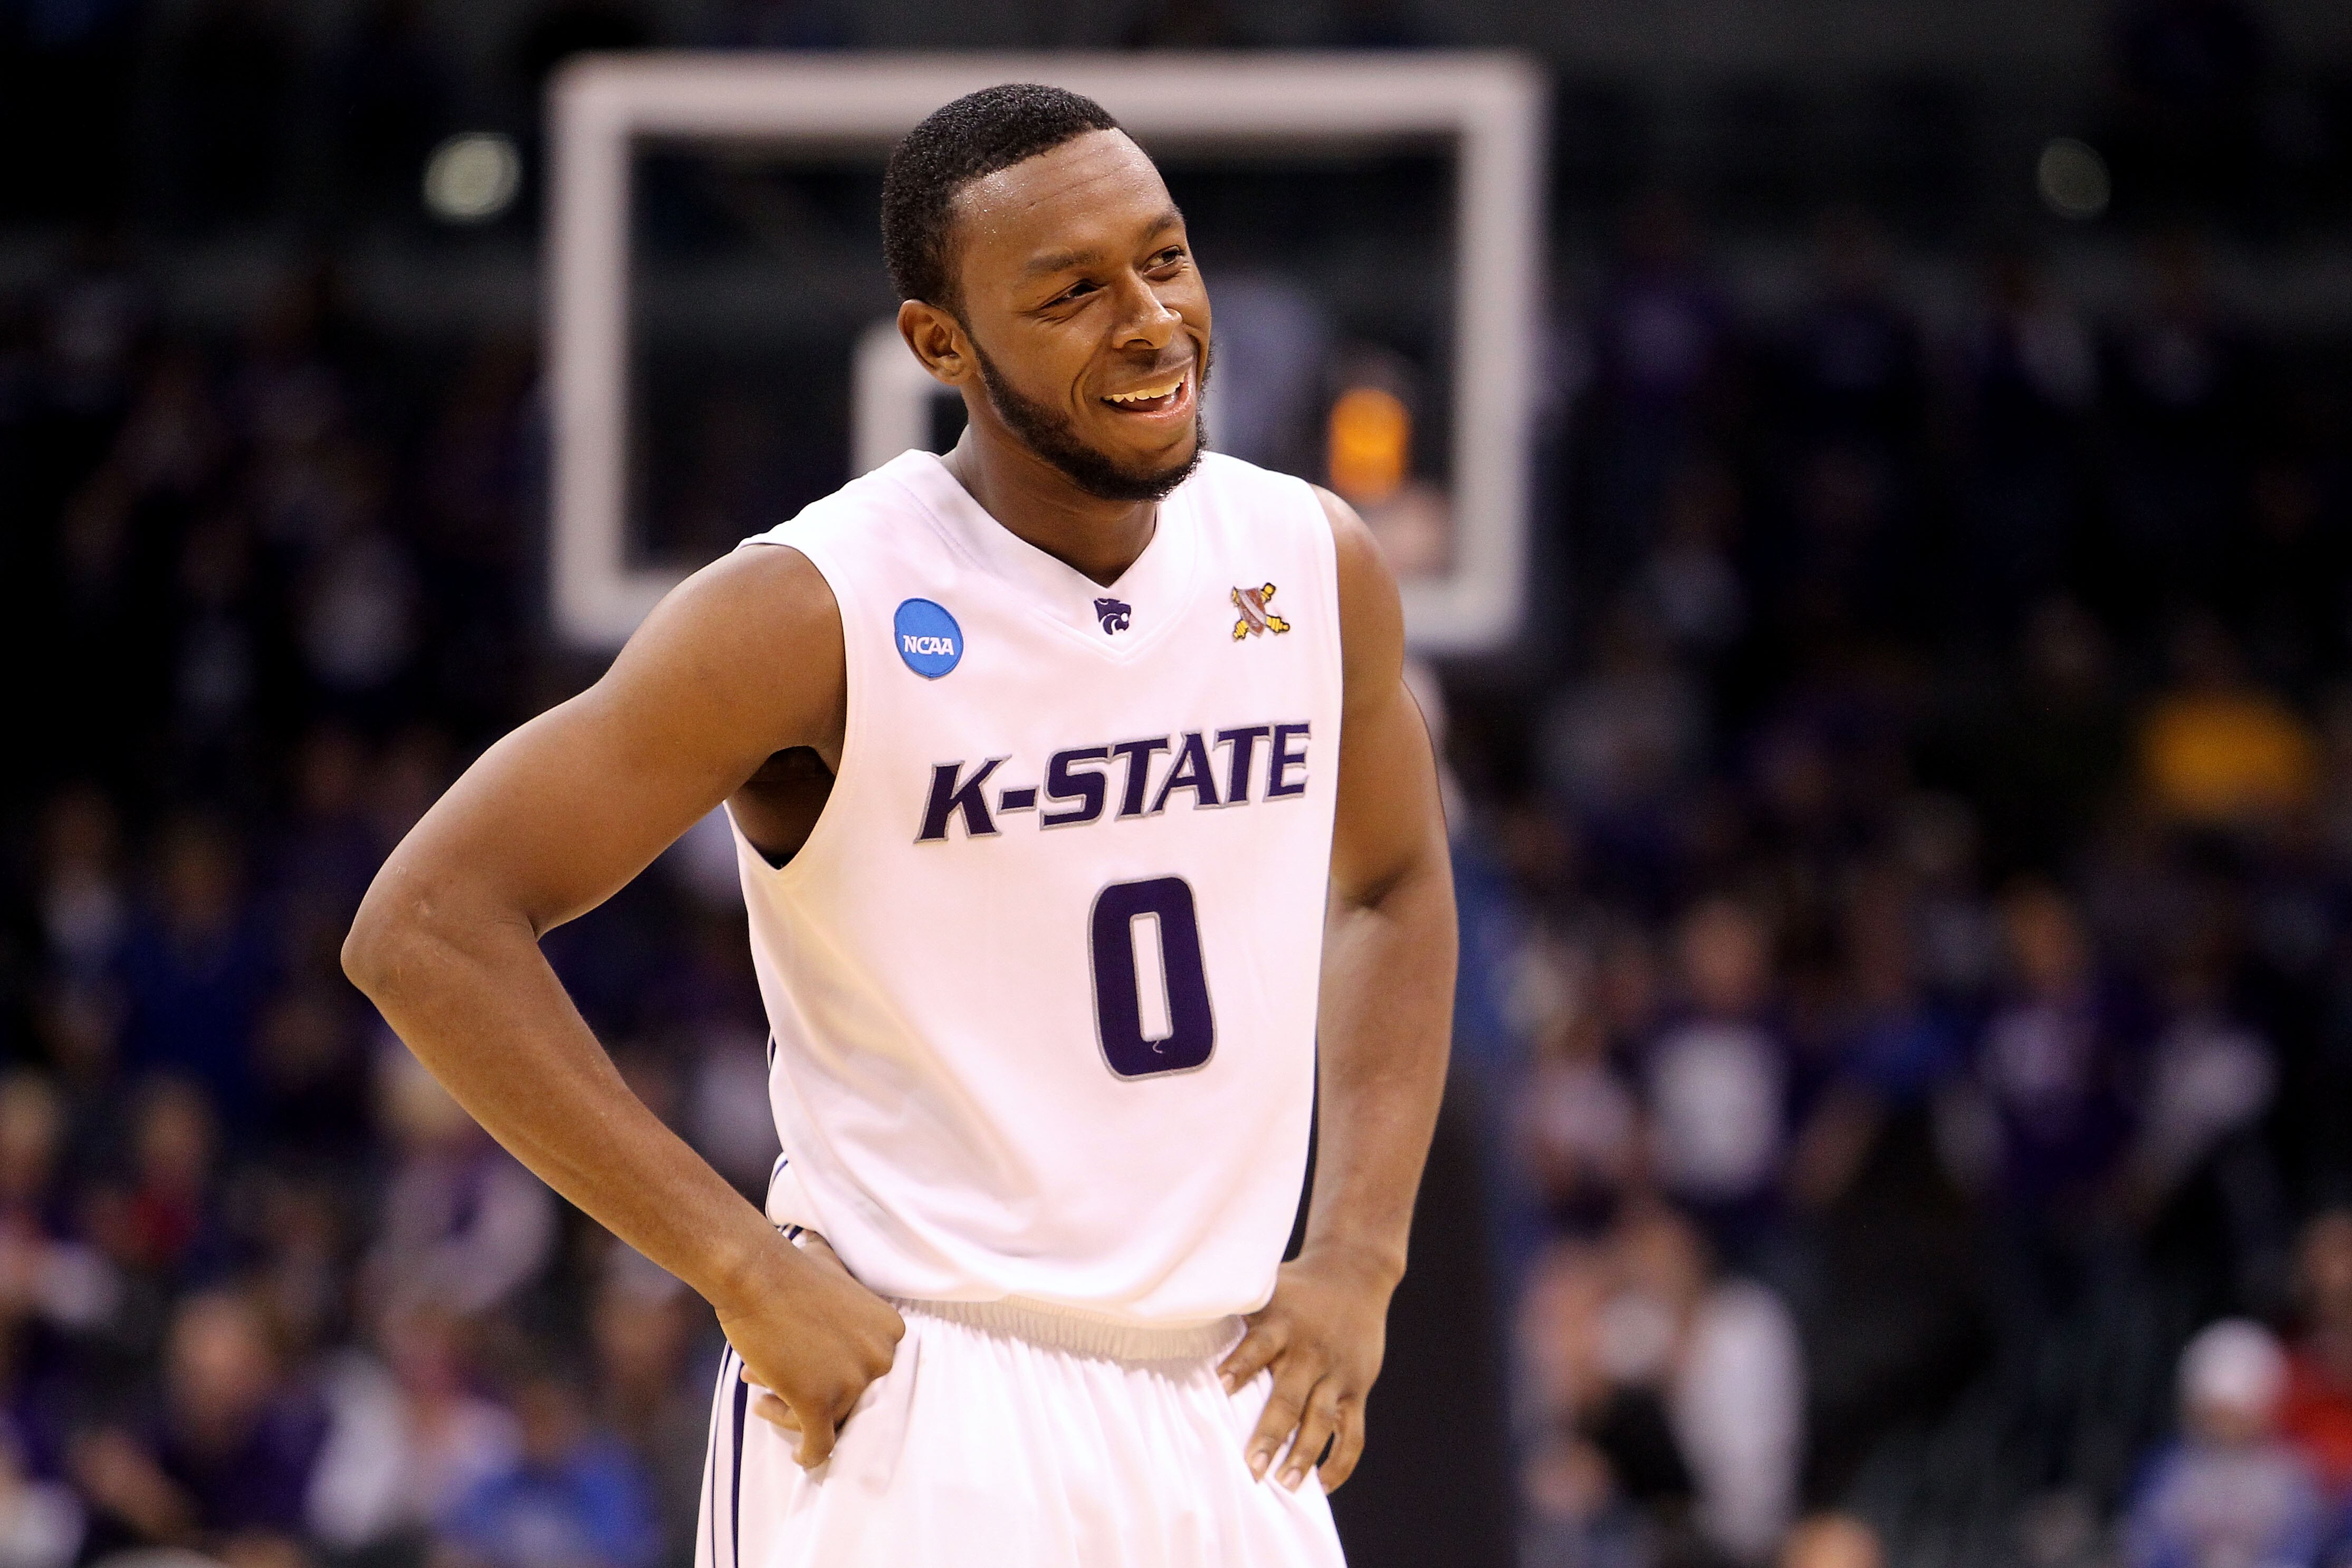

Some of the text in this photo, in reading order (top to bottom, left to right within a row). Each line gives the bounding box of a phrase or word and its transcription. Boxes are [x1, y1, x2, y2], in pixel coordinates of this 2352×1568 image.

[903, 635, 954, 656] NCAA
[914, 720, 1312, 844] K-STATE
[1087, 873, 1218, 1083] 0
